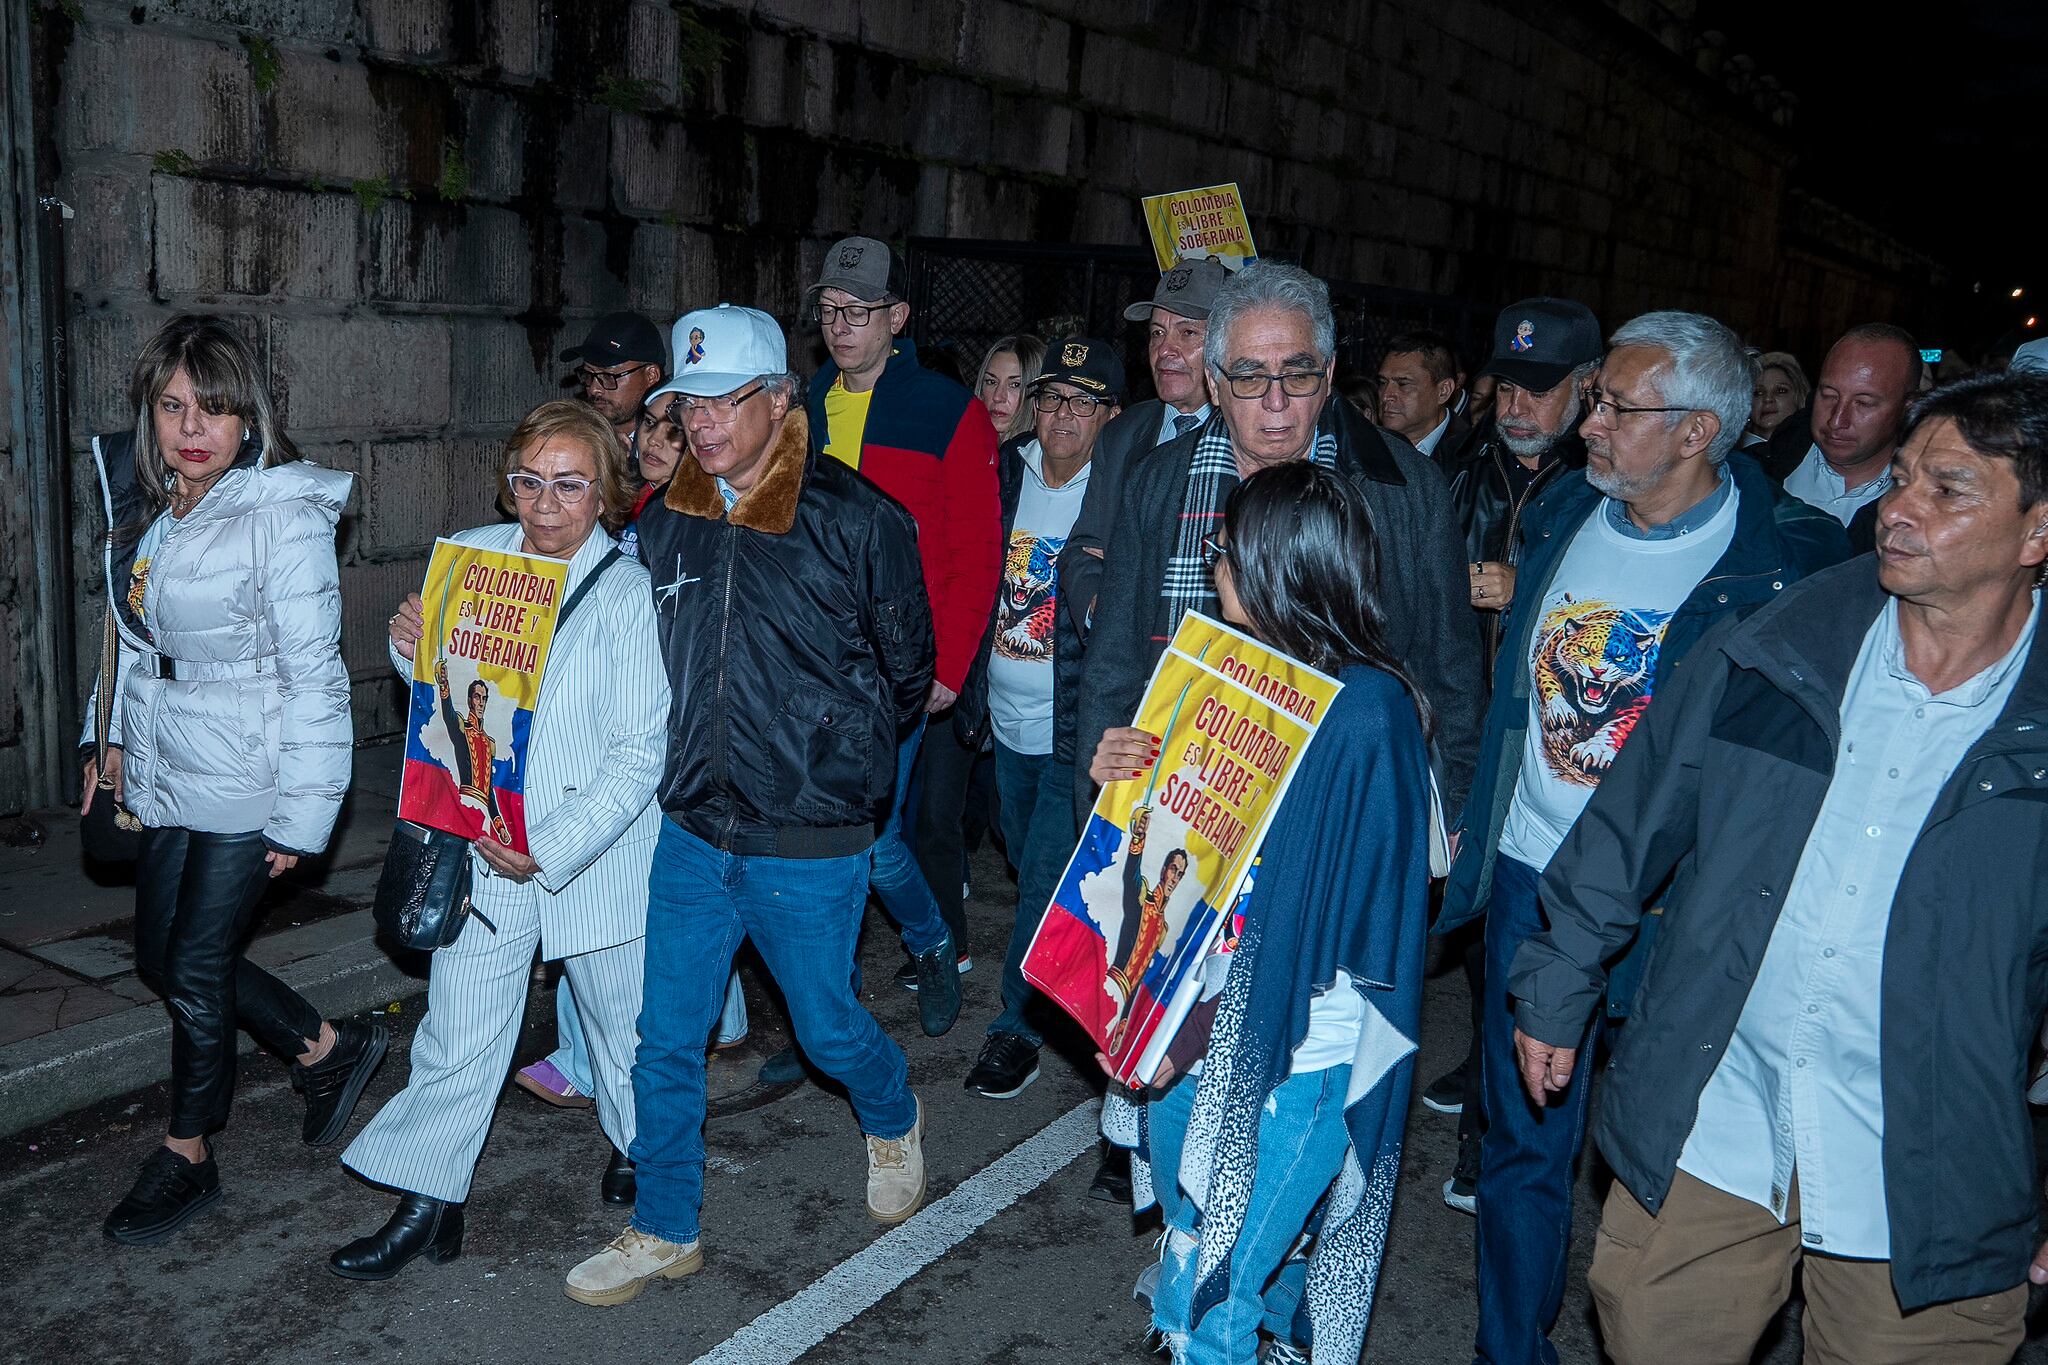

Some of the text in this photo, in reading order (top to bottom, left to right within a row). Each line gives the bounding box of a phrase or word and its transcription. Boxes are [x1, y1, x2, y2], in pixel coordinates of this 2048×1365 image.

[1171, 193, 1235, 216] COLOMBIA
[1177, 212, 1233, 231] ES LIBRE Y
[1179, 226, 1244, 250] SOBERANA
[463, 564, 556, 607] COLOMBIA
[459, 599, 539, 634] ES LIBRE Y
[448, 627, 539, 674] SOBERANA
[1194, 697, 1291, 781] COLOMBIA
[1183, 742, 1261, 809] ES LIBRE Y
[1159, 773, 1248, 860] SOBERANA
